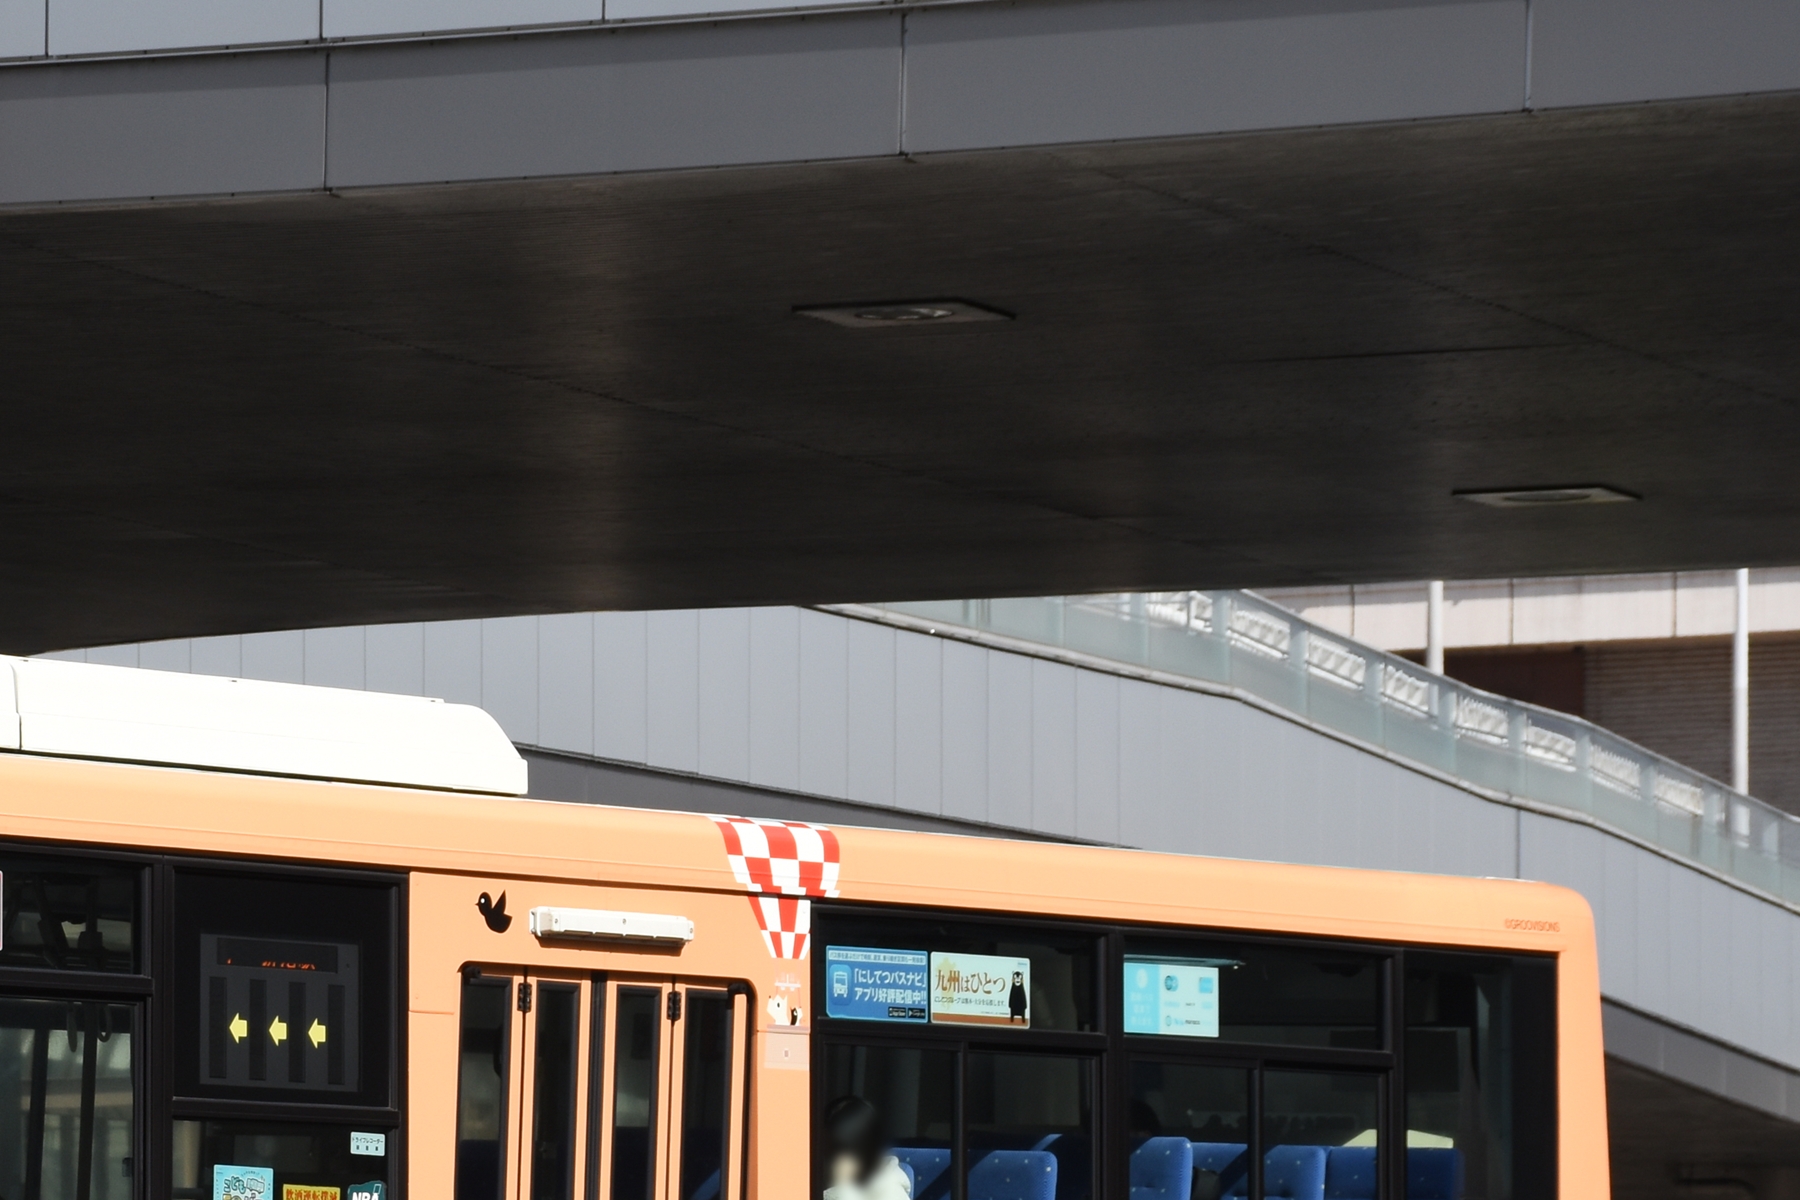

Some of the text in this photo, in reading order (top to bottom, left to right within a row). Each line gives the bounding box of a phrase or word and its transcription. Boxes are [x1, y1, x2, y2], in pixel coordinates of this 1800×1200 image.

[854, 968, 927, 987] 「にしてつバスナビ」
[935, 970, 1006, 994] 九州はひとつ
